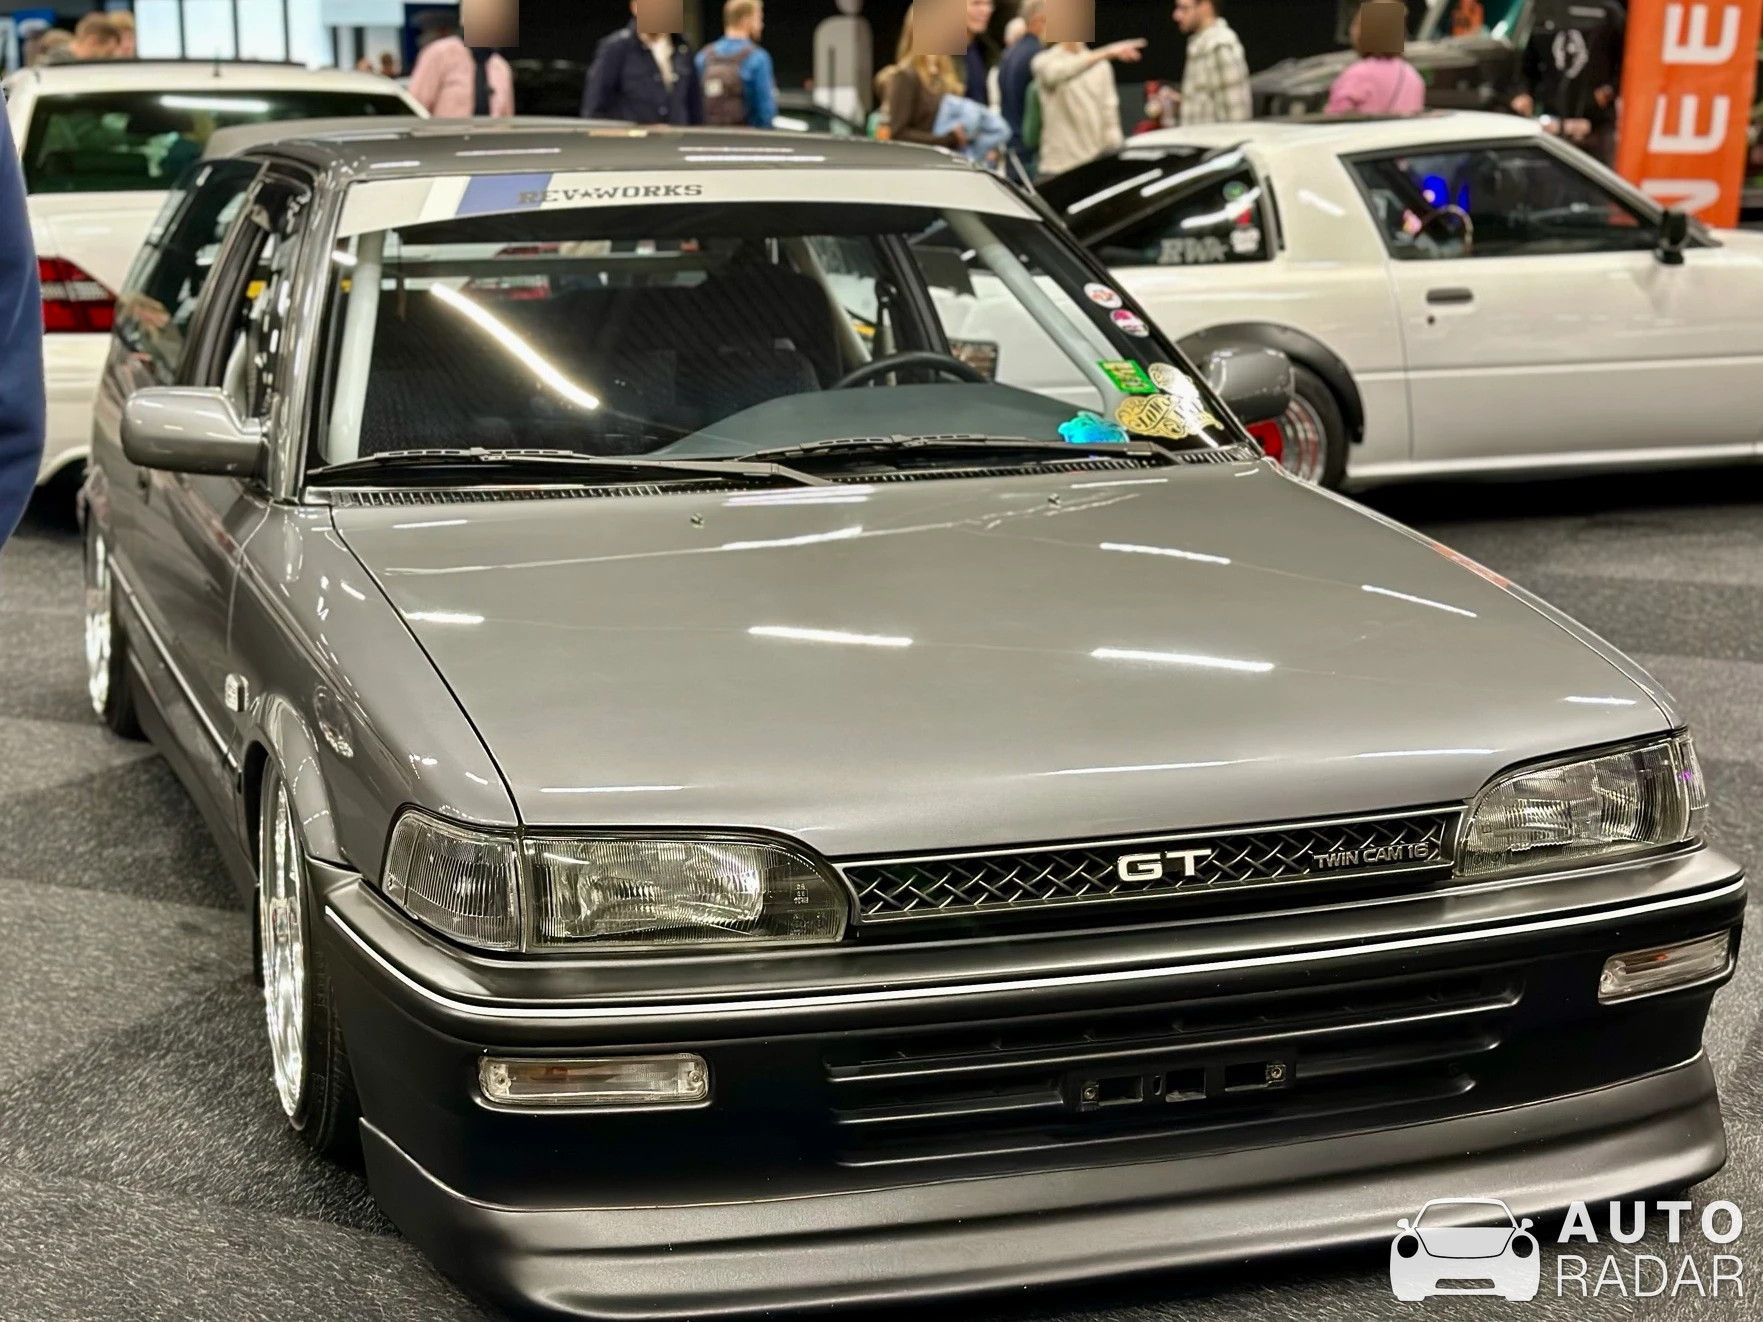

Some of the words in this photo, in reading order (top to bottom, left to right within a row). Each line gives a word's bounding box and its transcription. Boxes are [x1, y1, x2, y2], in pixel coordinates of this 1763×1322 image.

[1117, 849, 1212, 882] GT
[1313, 851, 1360, 868] TWIN
[1362, 845, 1403, 862] CAM
[1407, 841, 1429, 858] 16
